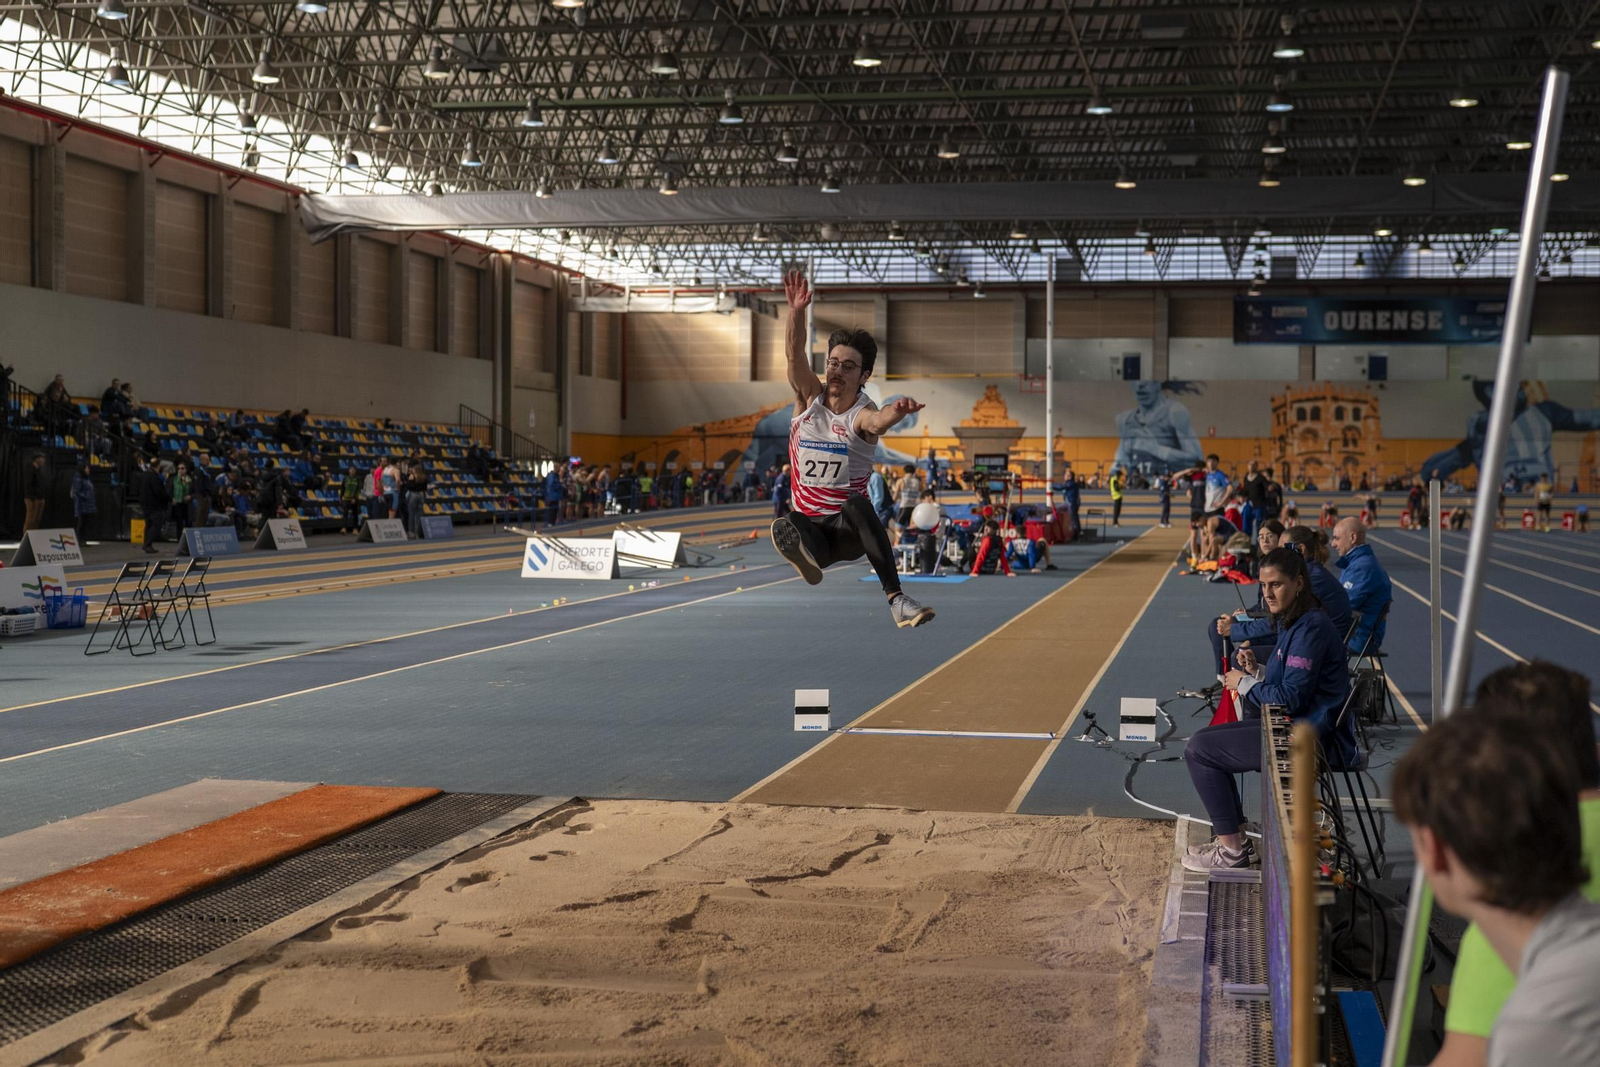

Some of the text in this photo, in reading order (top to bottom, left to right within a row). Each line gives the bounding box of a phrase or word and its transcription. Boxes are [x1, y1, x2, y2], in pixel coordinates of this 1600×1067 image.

[1324, 310, 1443, 331] OURENSE
[805, 460, 842, 478] 277
[37, 552, 80, 563] Expourense
[559, 547, 610, 557] DEPORTE
[558, 560, 604, 571] GALEGO
